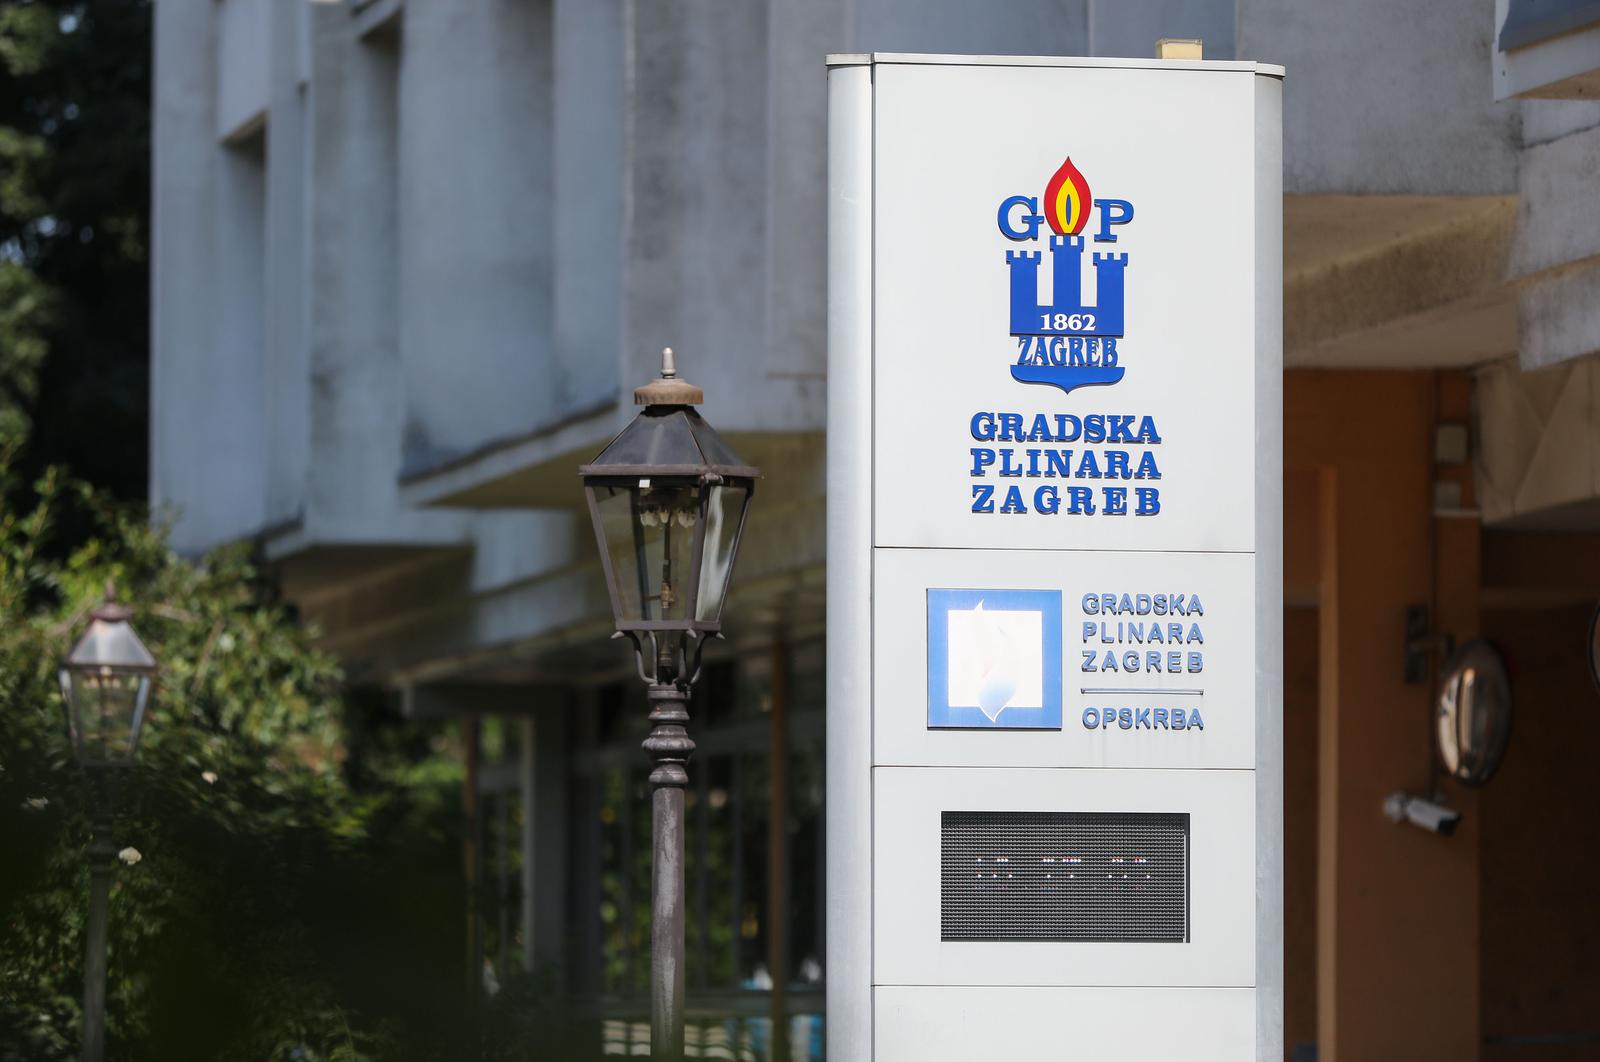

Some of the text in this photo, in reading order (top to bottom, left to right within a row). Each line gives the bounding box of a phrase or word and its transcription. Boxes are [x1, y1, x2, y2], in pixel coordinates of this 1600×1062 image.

[1040, 313, 1097, 331] 1862
[1017, 335, 1119, 367] ZAGREB
[970, 411, 1162, 444] GRADSKA
[970, 447, 1162, 480] PLINARA
[971, 484, 1161, 517] ZAGREB
[1081, 592, 1204, 617] GRADSKA
[1082, 621, 1204, 645] PLINARA
[1081, 650, 1204, 673] ZAGREB
[1081, 706, 1205, 731] OPSKRBA
